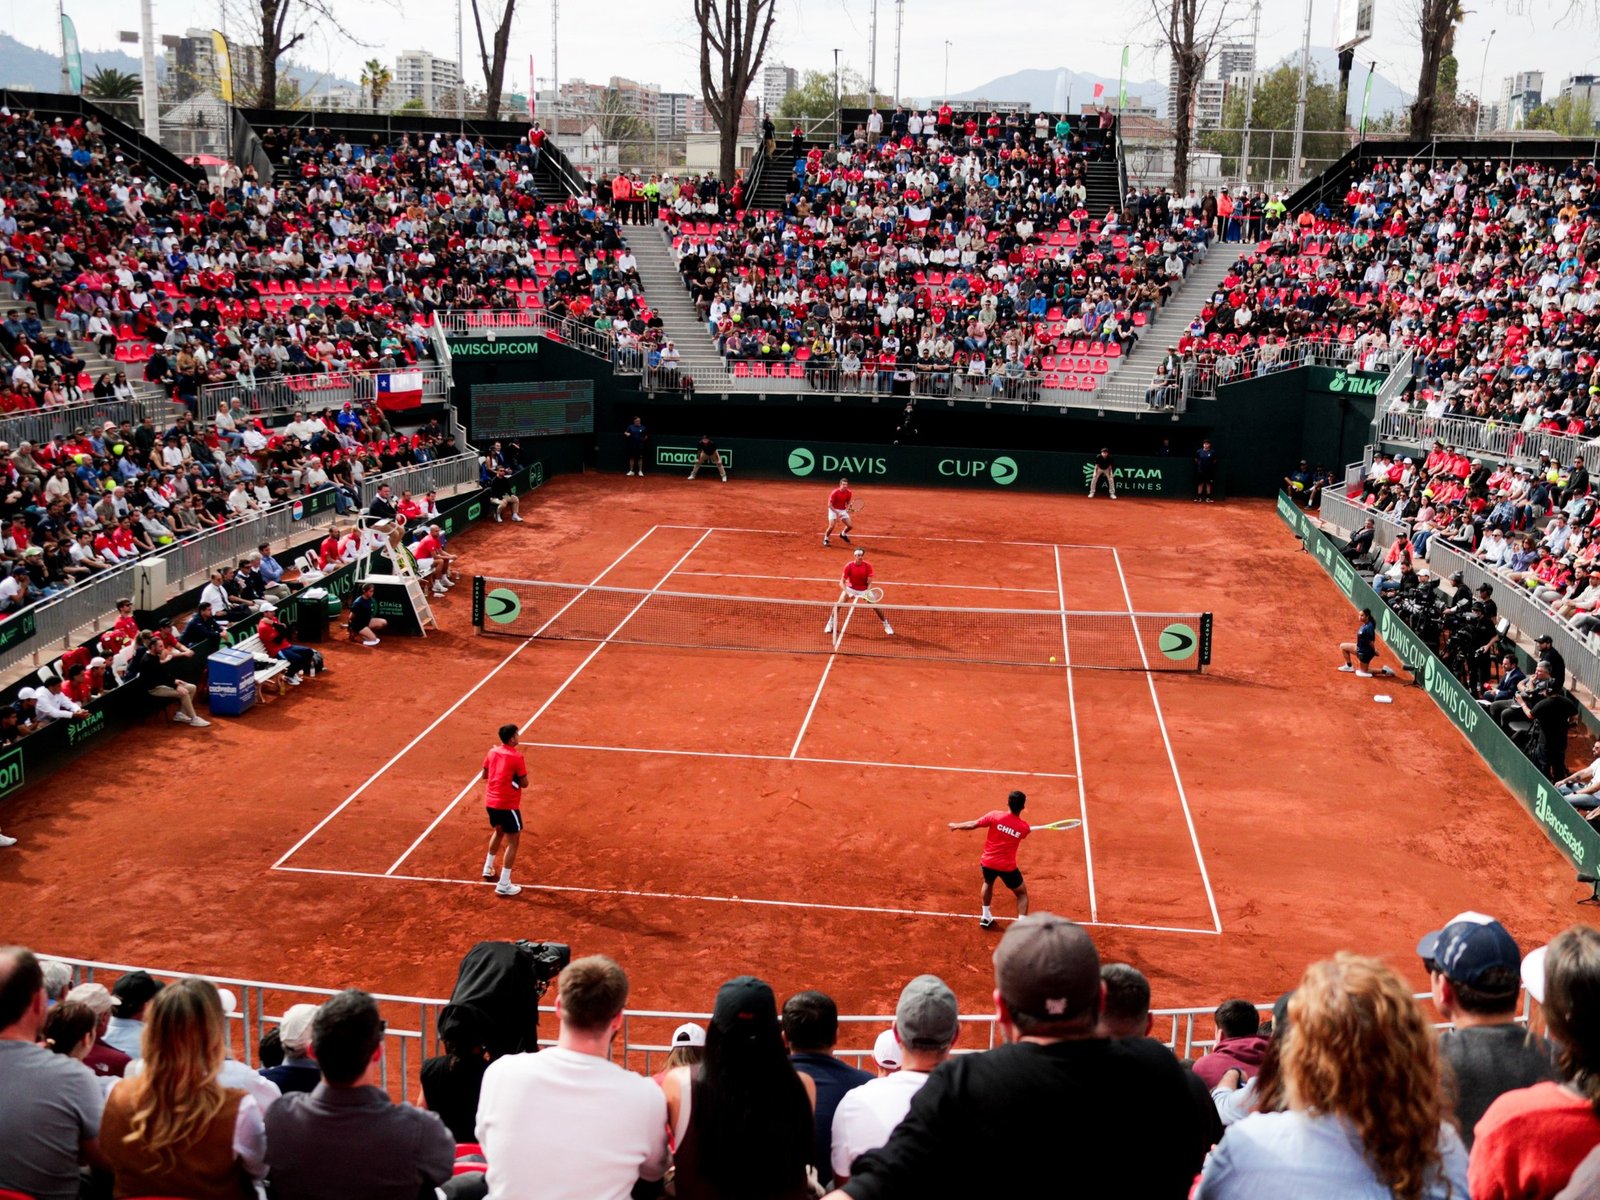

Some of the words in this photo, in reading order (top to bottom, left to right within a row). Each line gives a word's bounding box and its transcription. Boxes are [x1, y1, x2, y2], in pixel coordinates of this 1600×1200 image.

[660, 452, 728, 465] maran
[823, 455, 887, 475] DAVIS
[1112, 468, 1162, 479] ATAM
[1101, 481, 1162, 491] ARLINES
[1390, 622, 1410, 658] DAVIS
[1409, 644, 1425, 672] CUP
[1434, 672, 1458, 713] DAVIS
[1458, 700, 1477, 732] CUP
[76, 710, 104, 732] LATAM
[997, 824, 1021, 838] CHILE
[1545, 805, 1585, 860] BancoEstado
